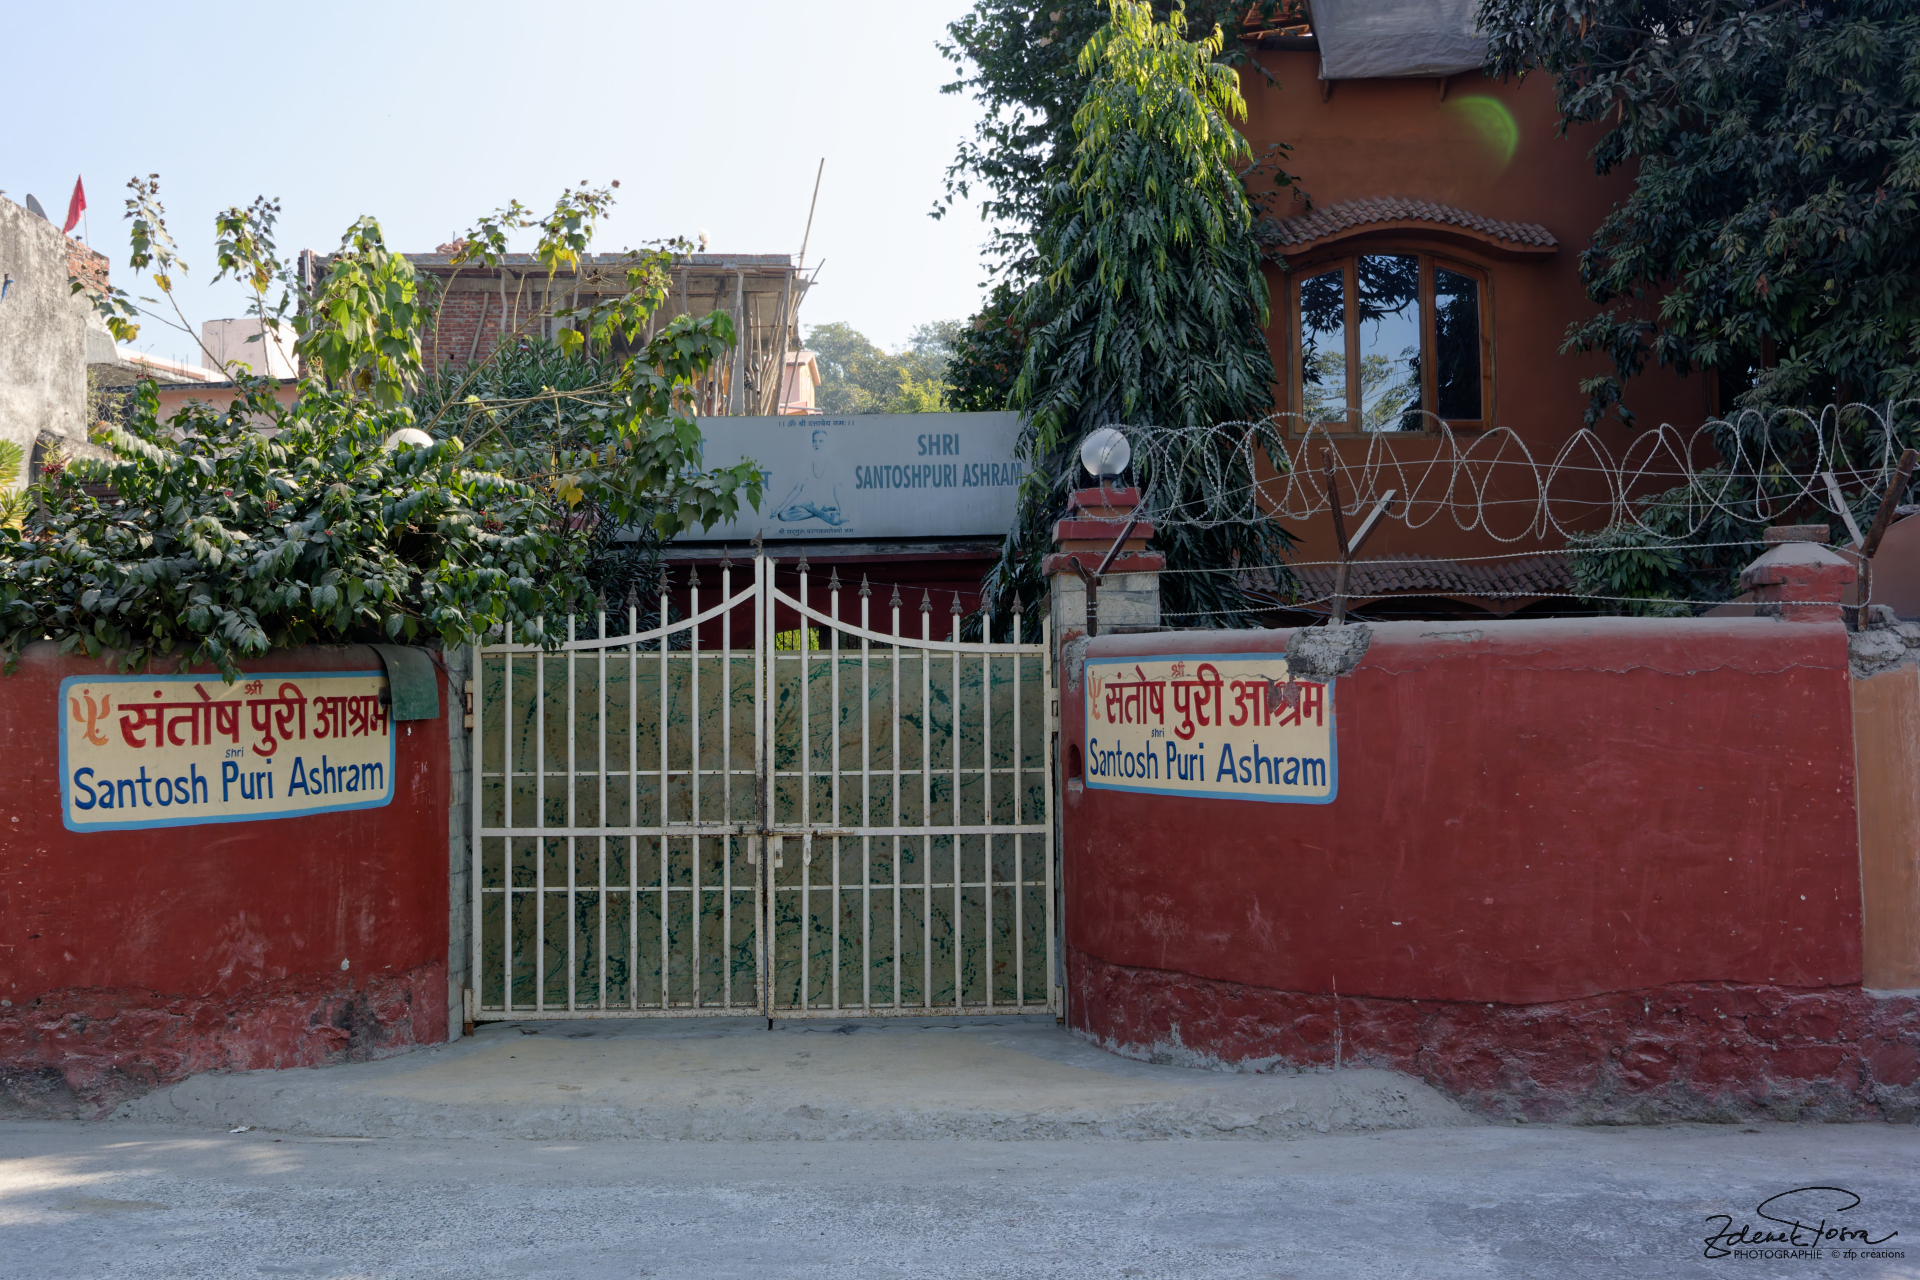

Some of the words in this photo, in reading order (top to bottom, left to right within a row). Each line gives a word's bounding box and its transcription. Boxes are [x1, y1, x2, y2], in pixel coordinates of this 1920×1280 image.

[917, 433, 960, 456] SHRI
[855, 464, 957, 490] SANTOSHPURI
[962, 462, 1023, 488] ASHRAM
[244, 679, 264, 696] श्री
[1171, 660, 1186, 678] श्री
[117, 683, 242, 749] संतोष
[246, 682, 307, 758] पुरी
[312, 695, 388, 739] आश्रम
[1104, 664, 1166, 725] संतोष
[1170, 662, 1224, 741] पुरी
[1228, 679, 1326, 728] आश्रम
[1089, 737, 1159, 780] Santosh
[1166, 741, 1205, 782] Puri
[1216, 743, 1327, 787] Ashram
[73, 763, 208, 811] Santosh
[221, 757, 274, 802] Puri
[287, 754, 384, 797] Ashram
